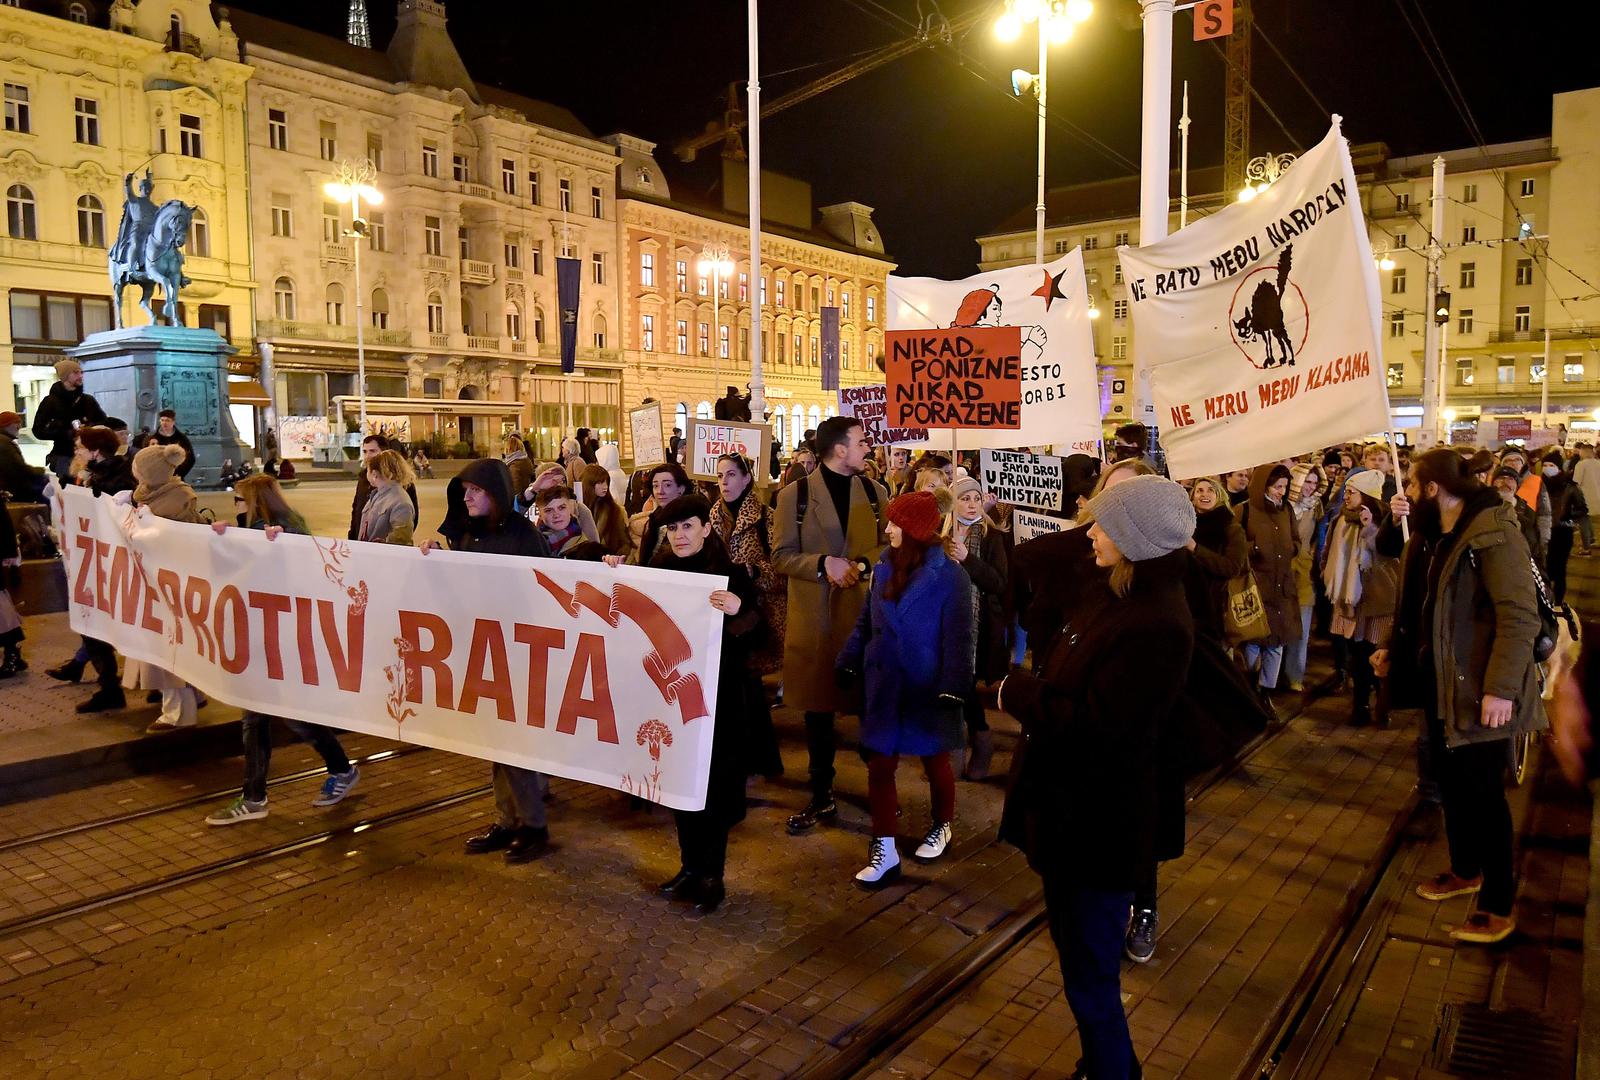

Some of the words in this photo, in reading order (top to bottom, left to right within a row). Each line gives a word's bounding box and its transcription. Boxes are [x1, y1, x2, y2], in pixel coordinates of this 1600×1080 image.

[1204, 3, 1222, 35] S
[1131, 278, 1147, 302] NE
[1155, 266, 1201, 296] RATU
[1209, 236, 1260, 281] MEĐU
[893, 336, 974, 362] NIKAD
[911, 356, 1019, 382] PONIZNE
[896, 380, 984, 402] NIKAD
[1170, 404, 1195, 428] NE
[1204, 390, 1249, 420] MIRU
[1258, 374, 1300, 409] MEĐU
[1304, 351, 1370, 392] KLASAMA
[698, 426, 743, 443] DIJETE
[706, 441, 747, 456] IZNAD
[992, 451, 1025, 464] DIJETE
[1028, 454, 1040, 464] JE
[985, 470, 997, 483] U
[1002, 463, 1030, 474] SAMO
[1033, 465, 1059, 477] BROJ
[1018, 515, 1061, 532] PLANIRAMO
[157, 568, 367, 693] PROTIV
[398, 610, 620, 745] RATA
